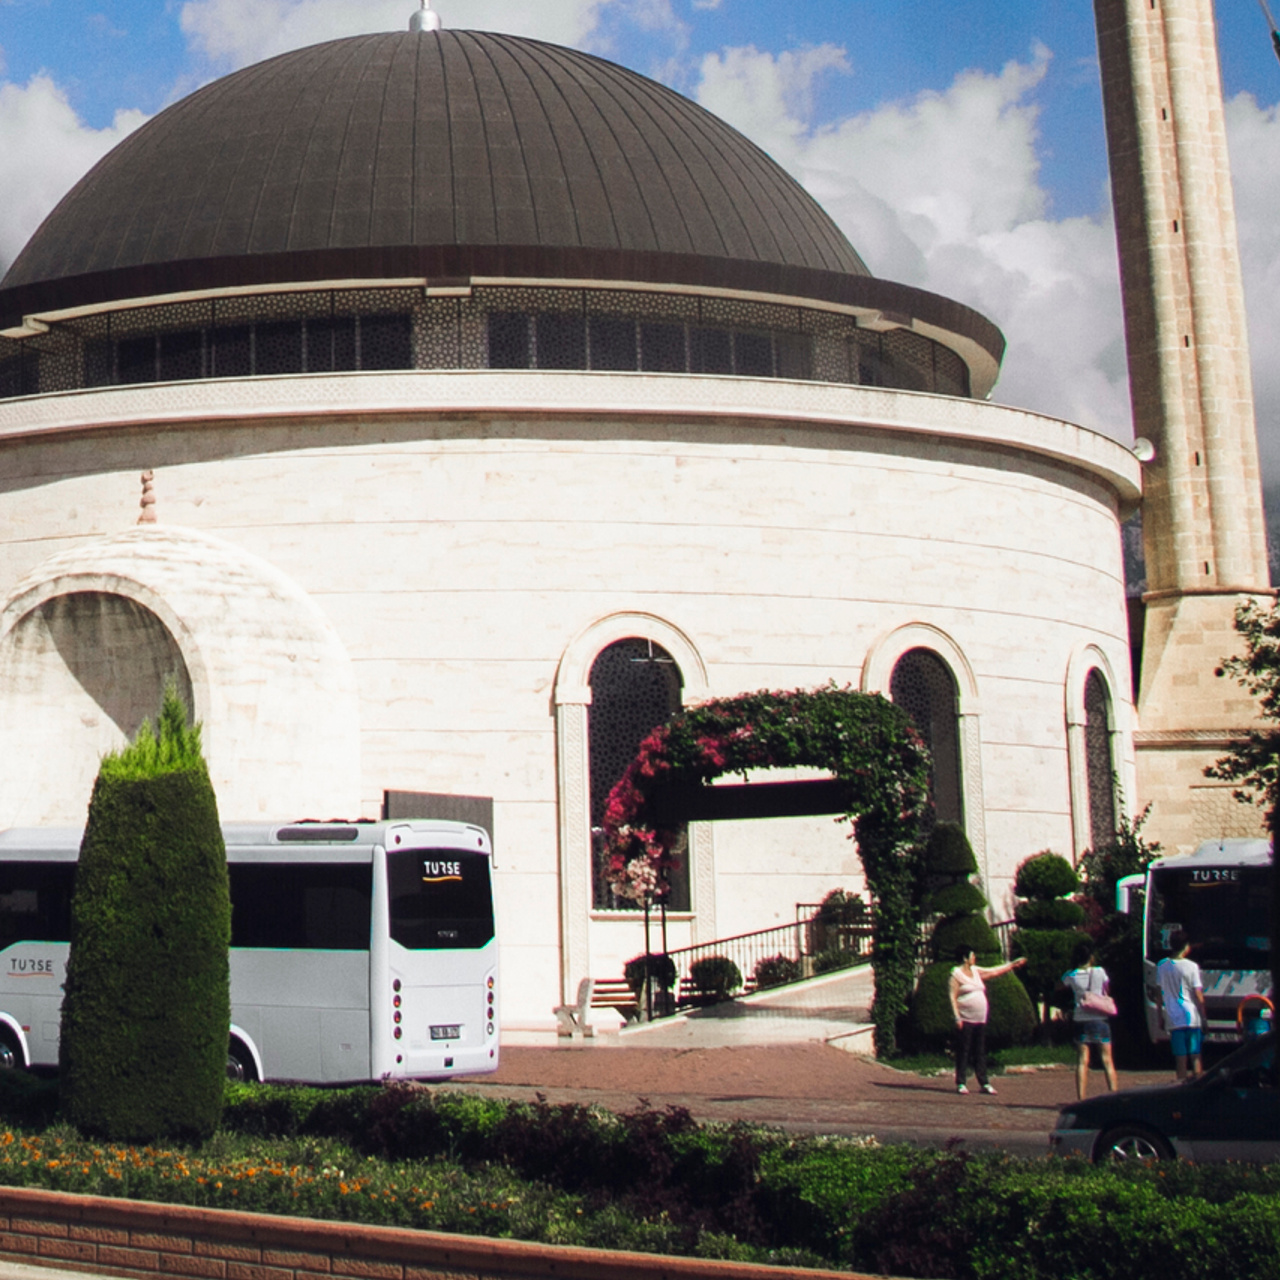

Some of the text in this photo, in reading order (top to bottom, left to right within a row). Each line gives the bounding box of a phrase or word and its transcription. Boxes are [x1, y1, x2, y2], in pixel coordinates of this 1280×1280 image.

[423, 861, 461, 875] TURSE
[1192, 870, 1239, 881] TURSE
[10, 958, 53, 972] TURSE
